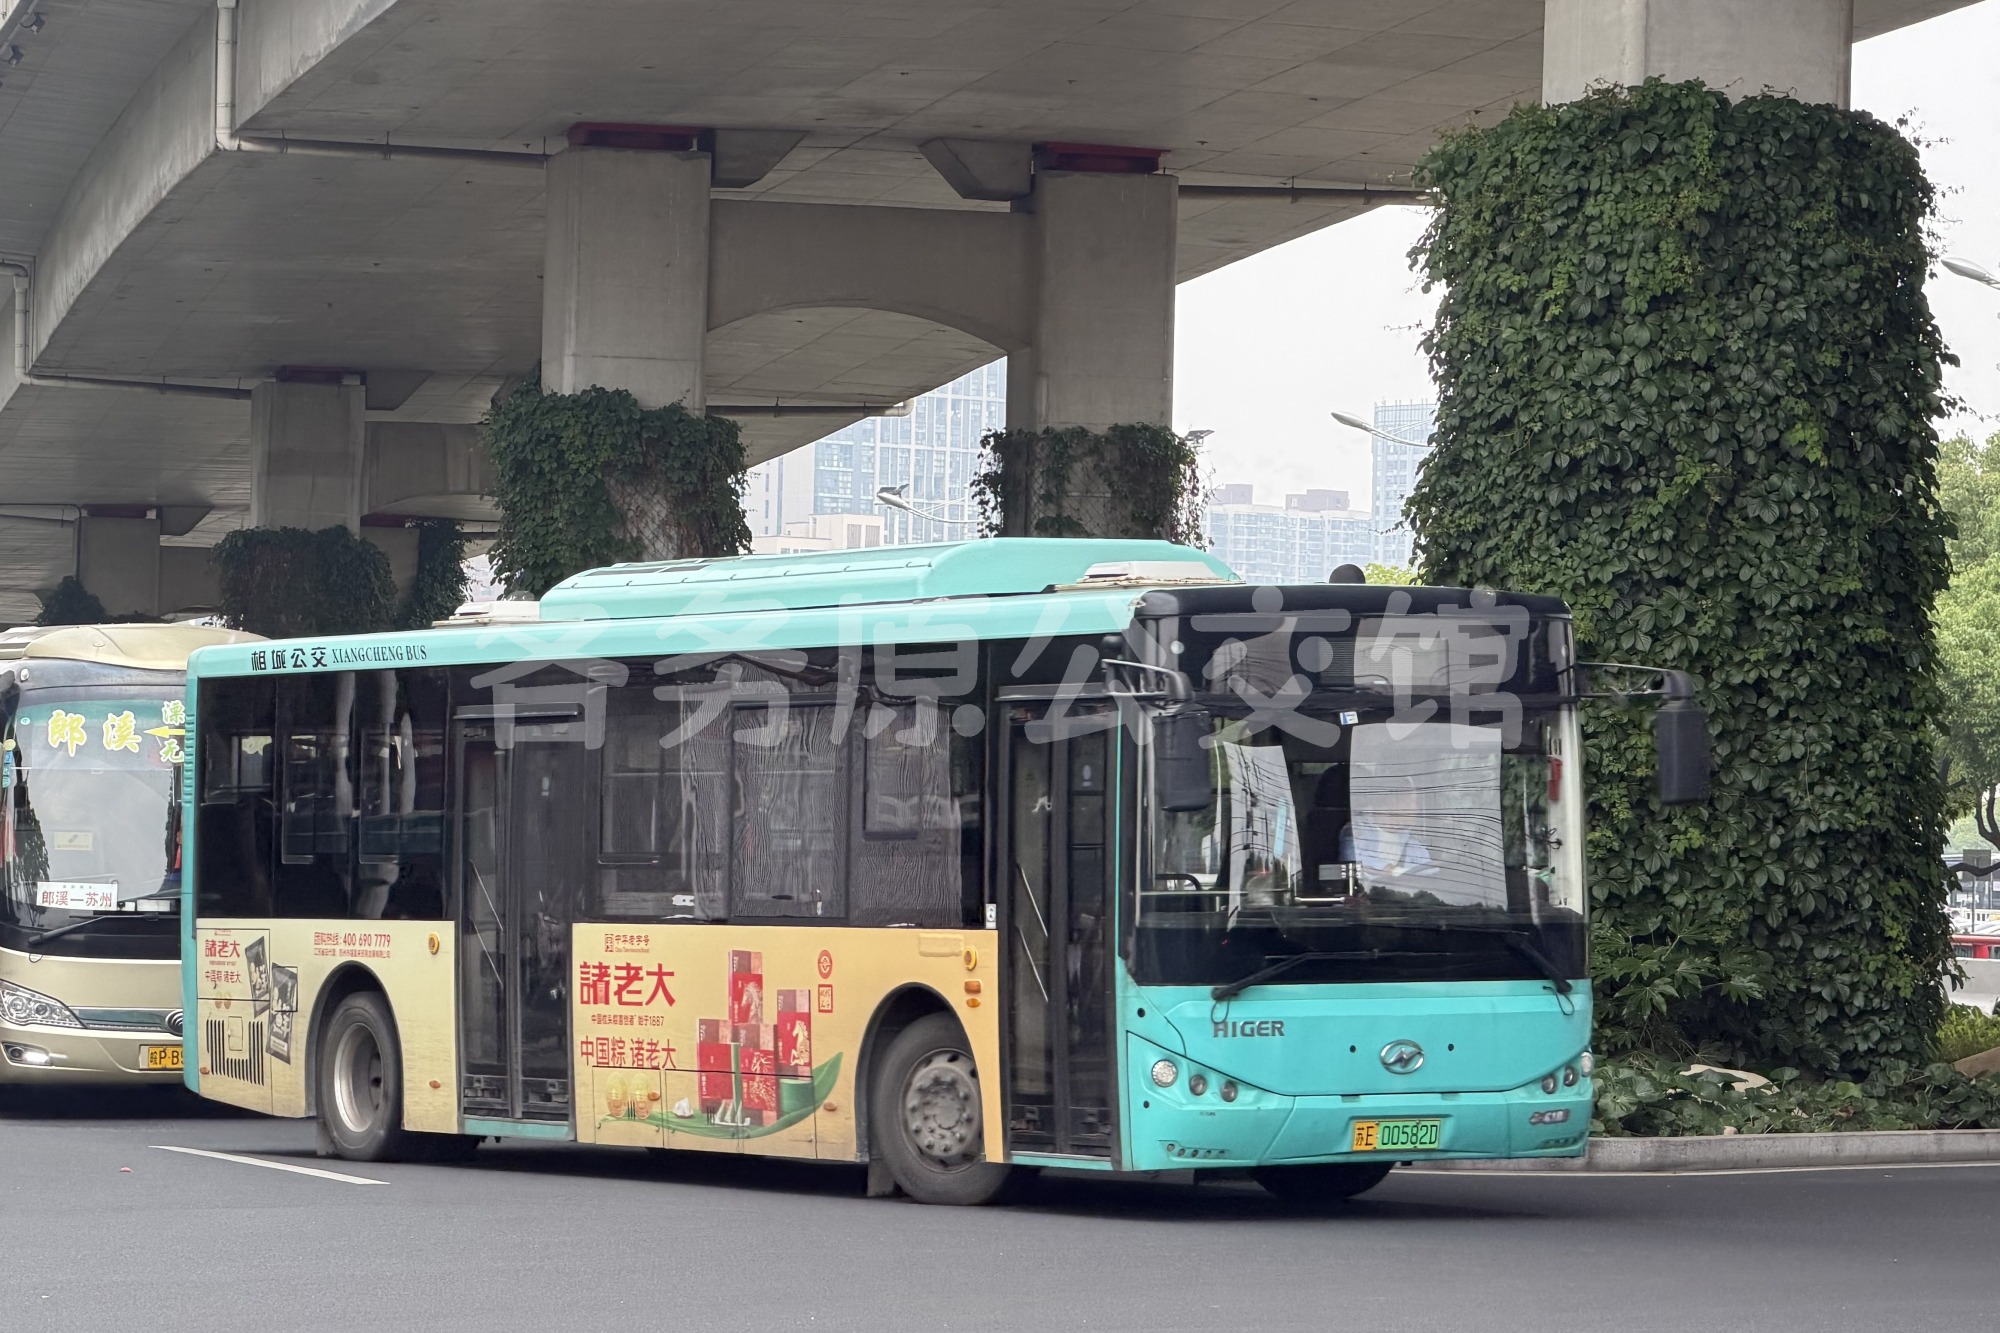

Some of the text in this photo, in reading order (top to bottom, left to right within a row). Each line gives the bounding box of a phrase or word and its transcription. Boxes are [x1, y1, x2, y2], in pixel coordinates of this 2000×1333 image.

[251, 646, 328, 672] 相城公交
[332, 645, 427, 664] XIANGCHENG BUS
[342, 932, 356, 947] 400
[358, 933, 372, 947] 690
[374, 933, 391, 948] 7779
[579, 961, 676, 1007] 諸老大
[1213, 1020, 1285, 1038] HIGER
[580, 1035, 677, 1069] 中国粽 诸老大
